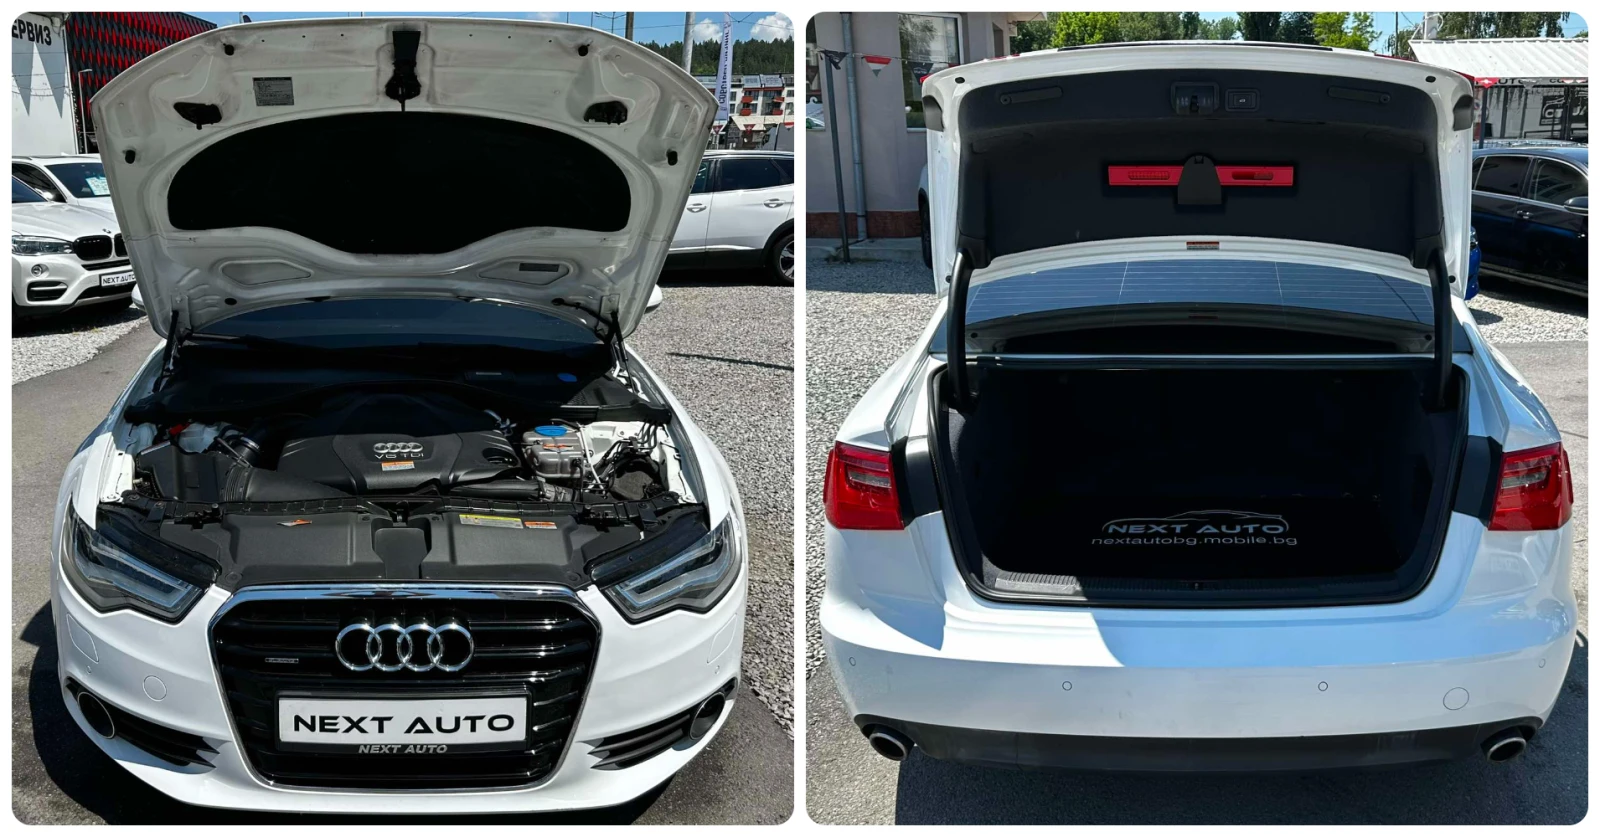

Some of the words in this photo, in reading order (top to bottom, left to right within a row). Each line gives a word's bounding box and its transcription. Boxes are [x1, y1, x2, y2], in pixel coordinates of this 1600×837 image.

[102, 276, 120, 284] NEXT
[1107, 524, 1189, 534] NEXT
[1196, 524, 1284, 534] AUTO
[1091, 536, 1298, 545] nextautobg.mobile.bg
[293, 714, 394, 734] NEXT
[404, 714, 515, 734] AUTO
[358, 744, 402, 754] NEXT
[404, 744, 448, 754] AUTO
